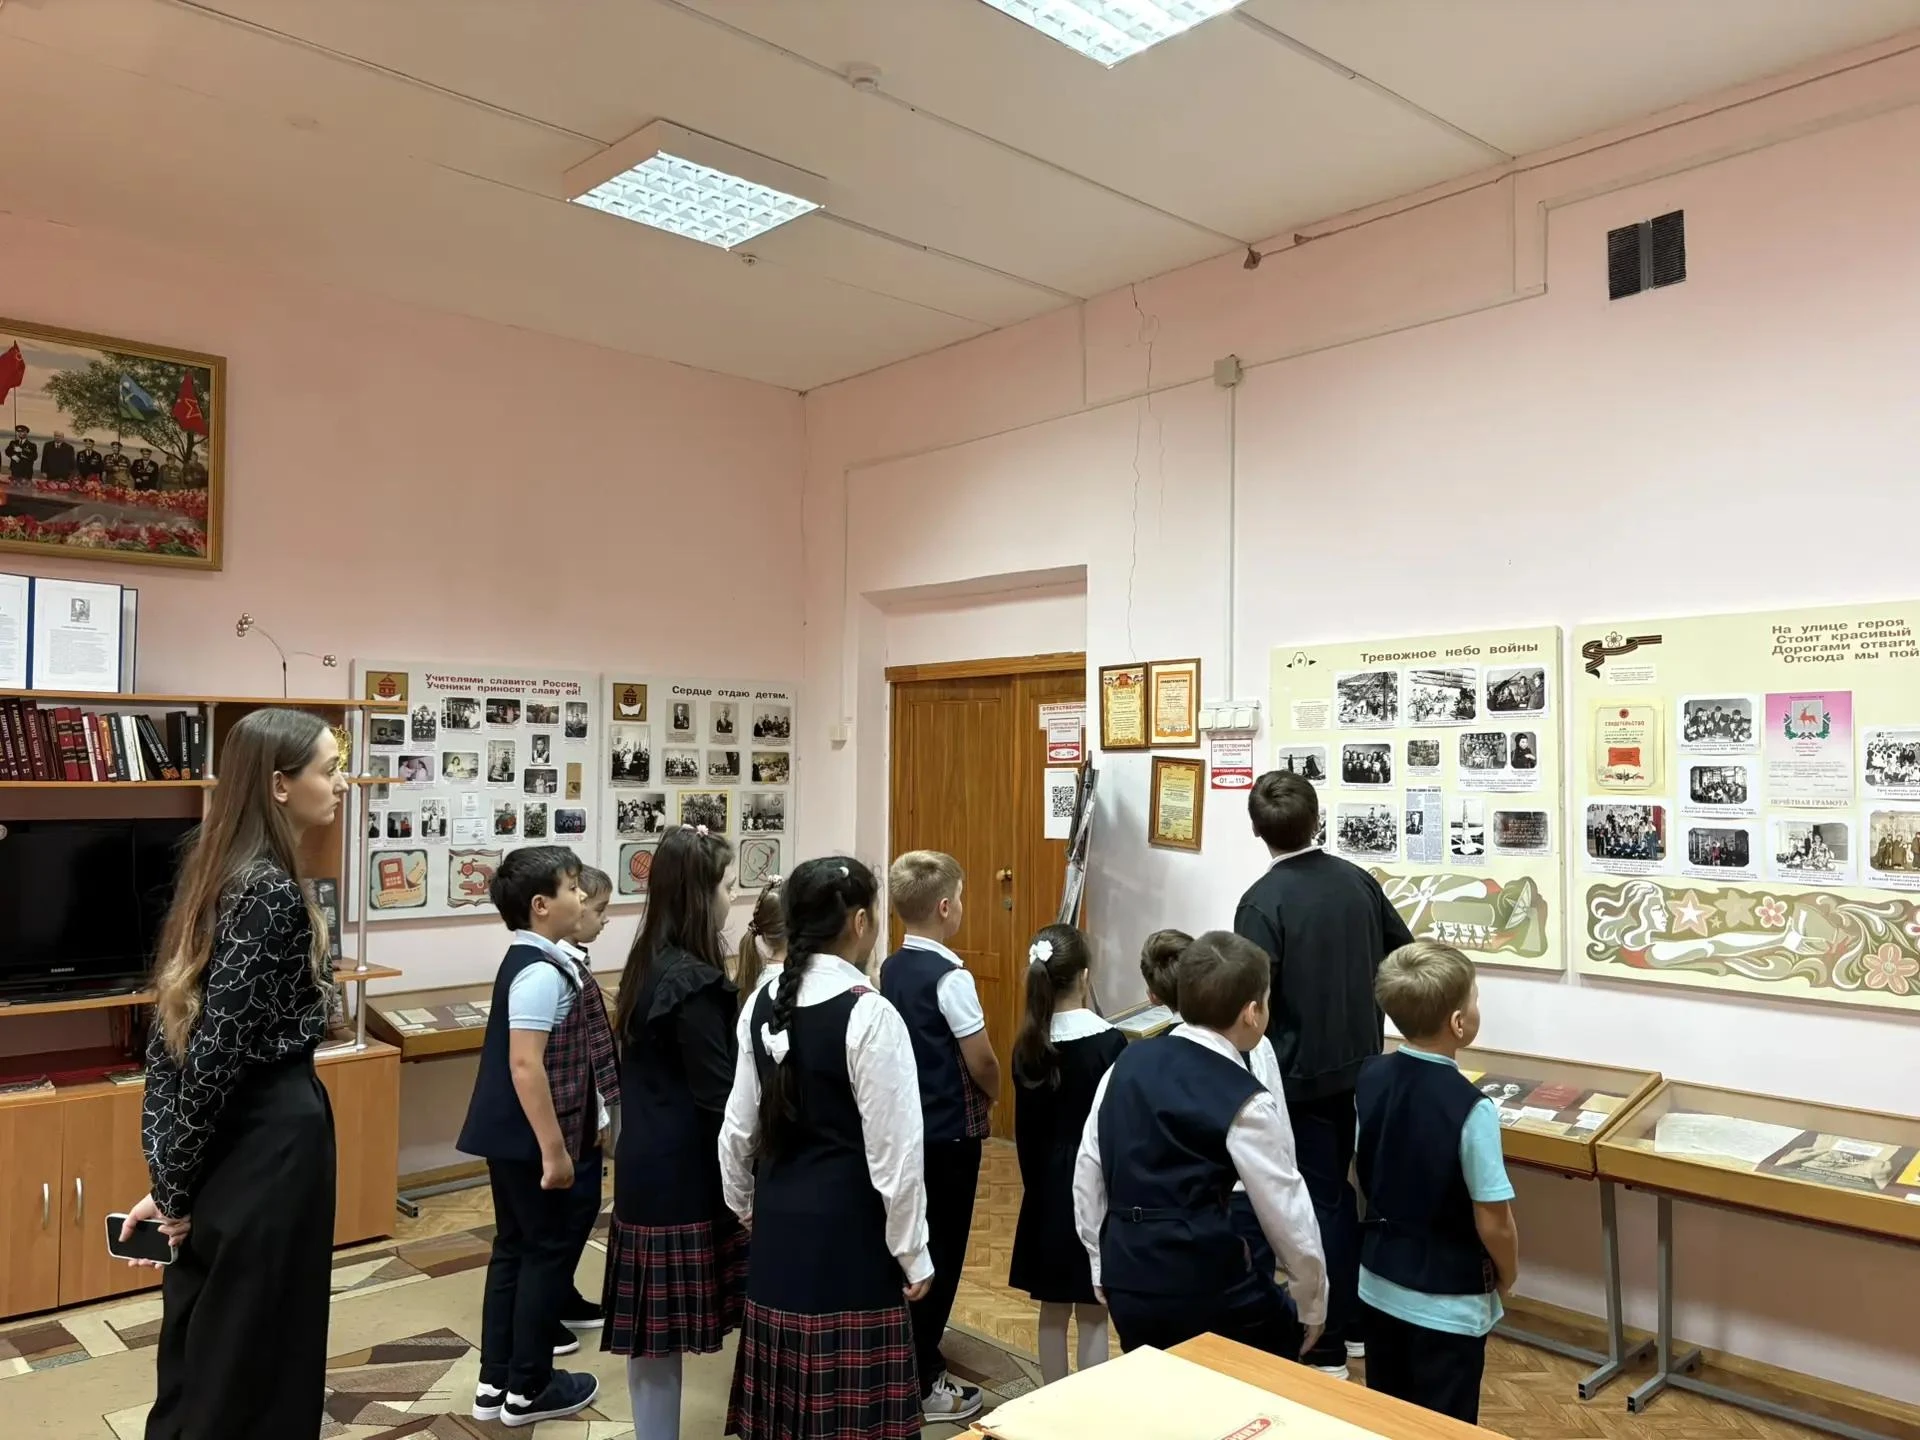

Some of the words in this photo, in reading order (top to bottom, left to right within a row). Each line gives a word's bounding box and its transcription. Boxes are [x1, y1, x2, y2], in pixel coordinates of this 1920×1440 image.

[1772, 626, 1791, 634] На
[1801, 622, 1848, 634] улице
[1858, 619, 1904, 629] героя
[1776, 634, 1822, 644] Стоит
[1831, 627, 1911, 642] красивый
[1360, 650, 1436, 664] Тревожное
[1445, 645, 1480, 656] небо
[1490, 643, 1538, 654] войны
[1772, 643, 1850, 656] Дорогами
[1860, 639, 1916, 649] отваги
[1784, 654, 1844, 664] Отсюда
[1854, 652, 1878, 660] мы
[425, 674, 483, 684] Учителями
[490, 678, 537, 686] славится
[426, 682, 471, 691] Ученики
[478, 686, 526, 694] приносят
[532, 688, 560, 696] славу
[566, 687, 581, 696] ей!
[672, 686, 712, 696] Сердце
[718, 689, 750, 698] отдаю
[756, 691, 788, 700] детям.
